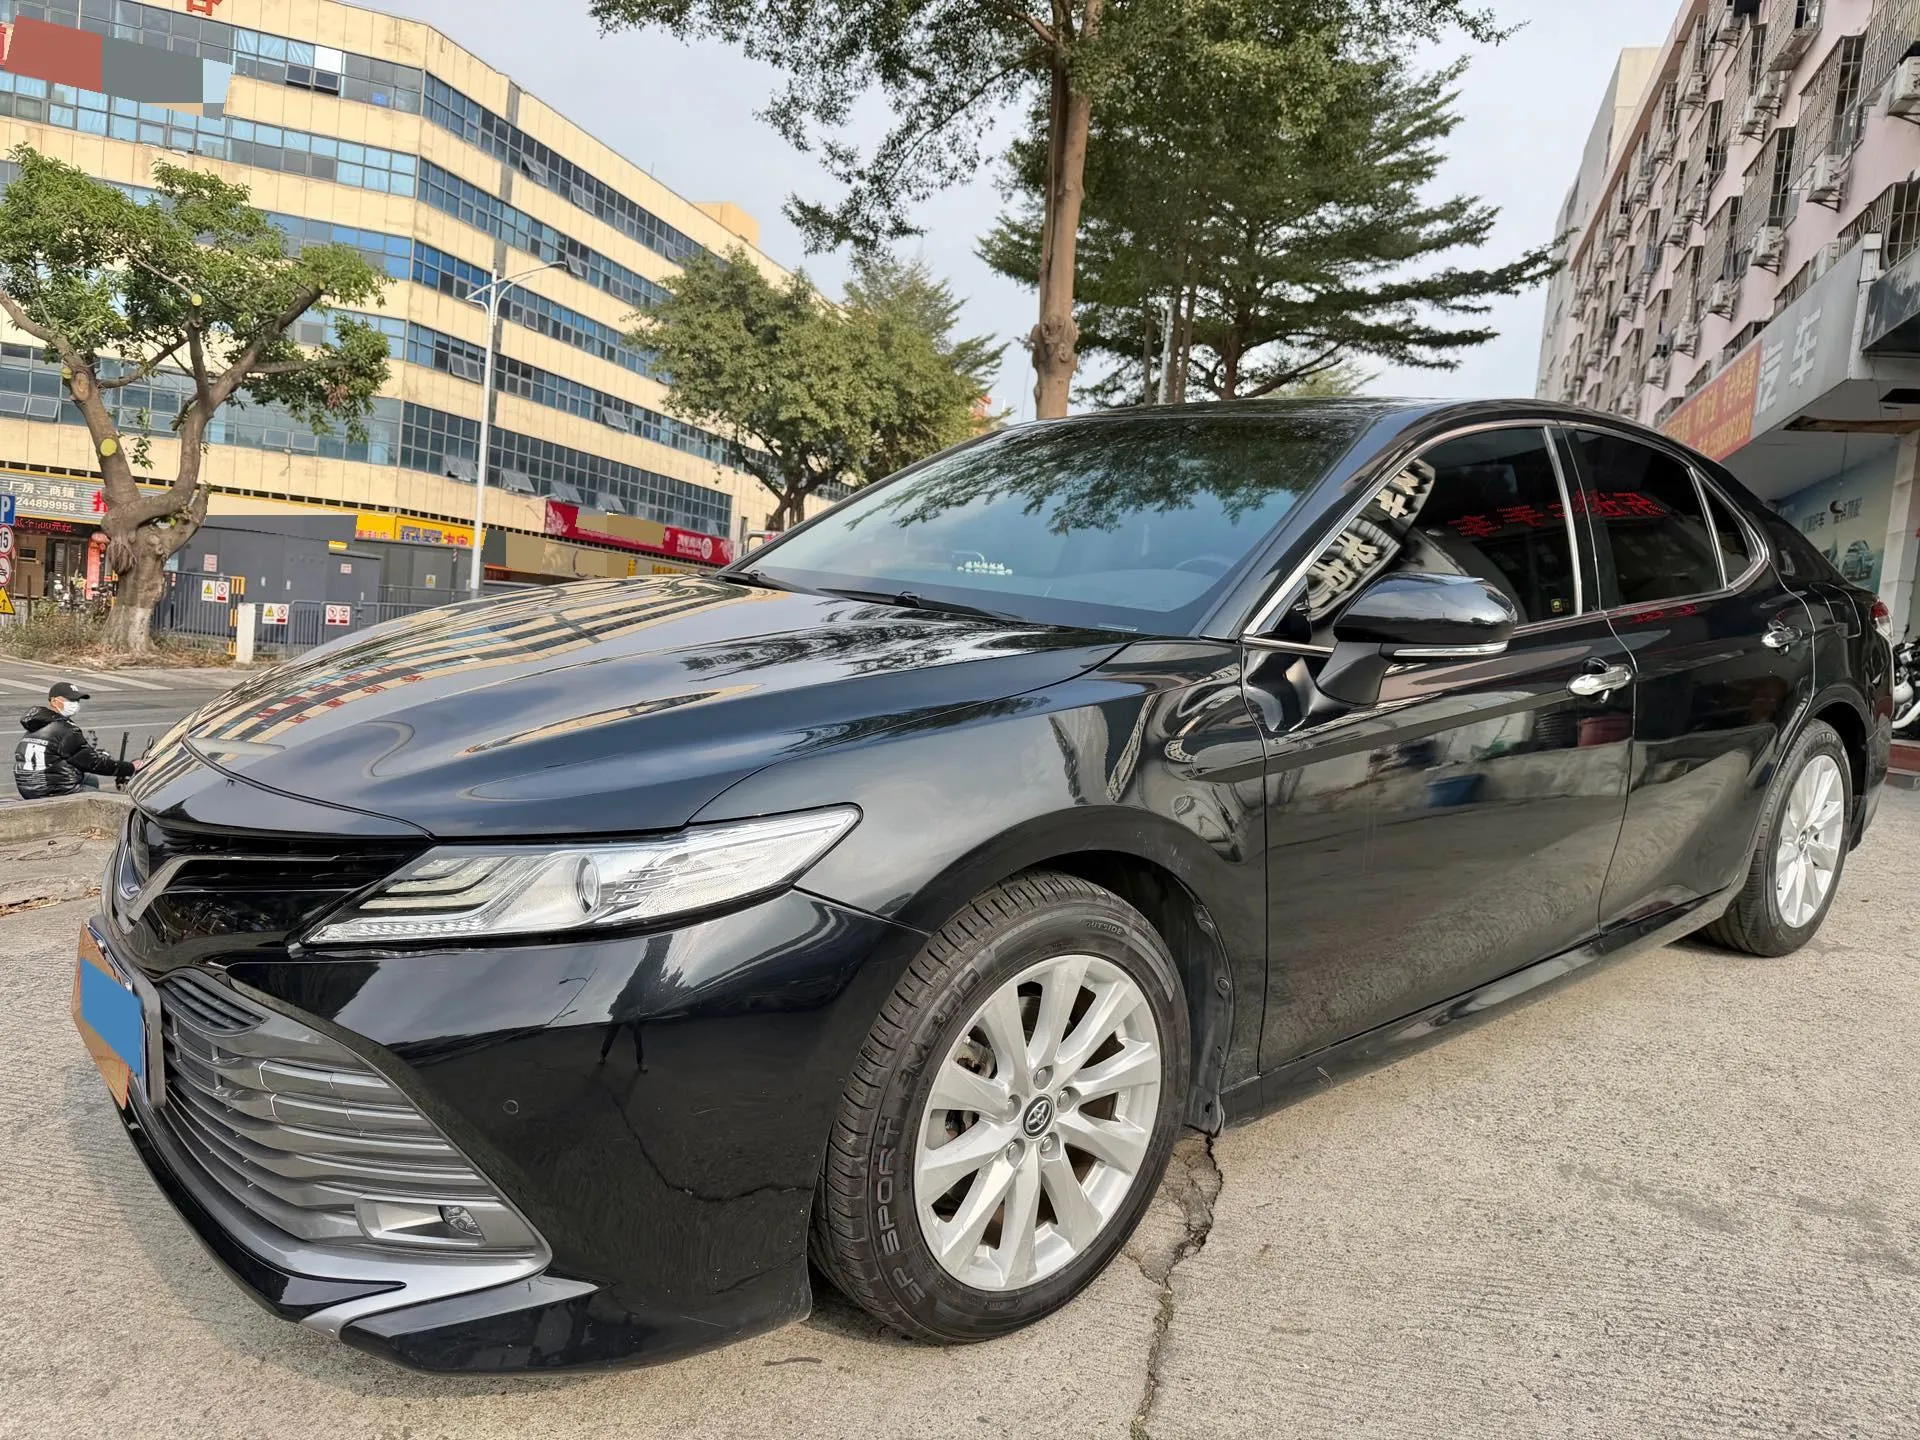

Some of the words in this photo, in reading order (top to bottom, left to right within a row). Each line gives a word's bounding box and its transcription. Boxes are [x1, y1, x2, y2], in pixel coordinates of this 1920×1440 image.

[1, 496, 11, 522] P
[877, 1118, 901, 1256] SPORT
[892, 1267, 926, 1304] SP
